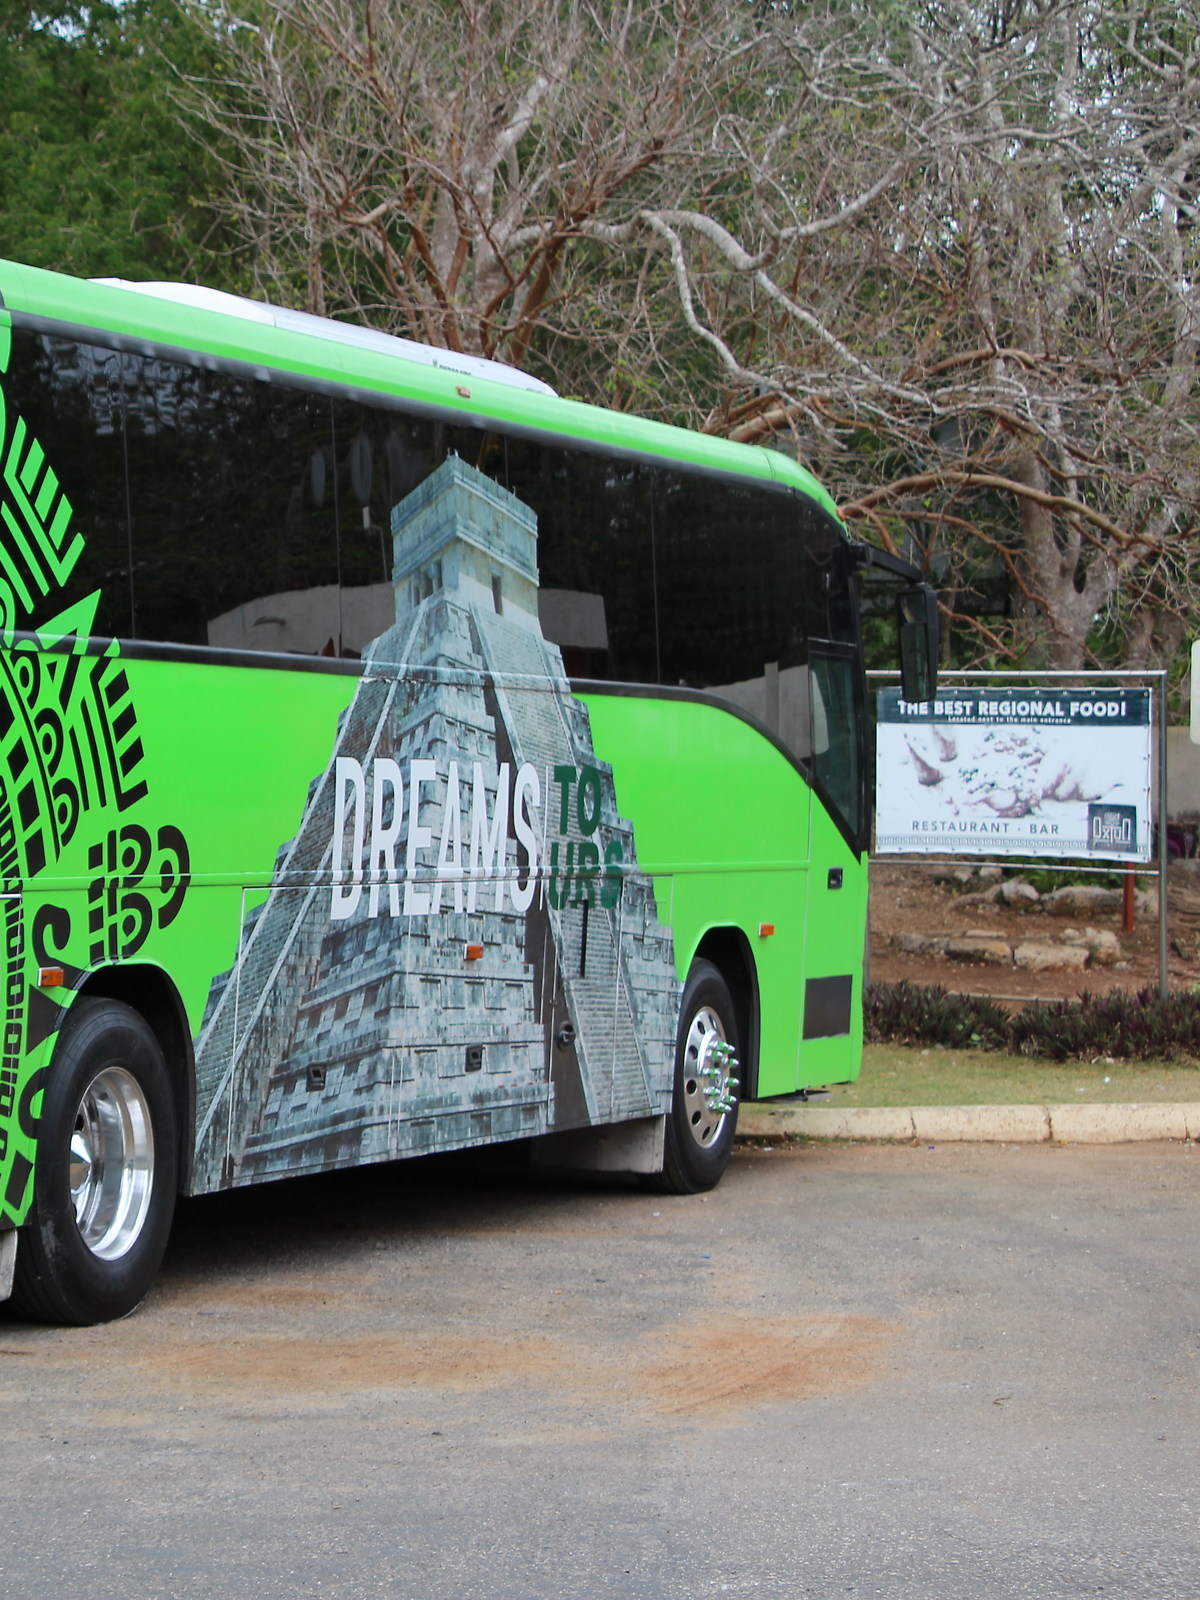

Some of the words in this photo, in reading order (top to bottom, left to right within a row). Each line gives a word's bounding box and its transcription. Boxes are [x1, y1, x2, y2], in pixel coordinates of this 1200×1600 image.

[897, 700, 928, 715] THE
[934, 700, 973, 715] BEST
[978, 701, 1064, 716] REGIONAL
[554, 765, 601, 836] TO
[912, 820, 1009, 834] RESTAURANT
[1029, 823, 1059, 835] BAR
[331, 756, 540, 920] DREAMS
[550, 841, 624, 910] URS
